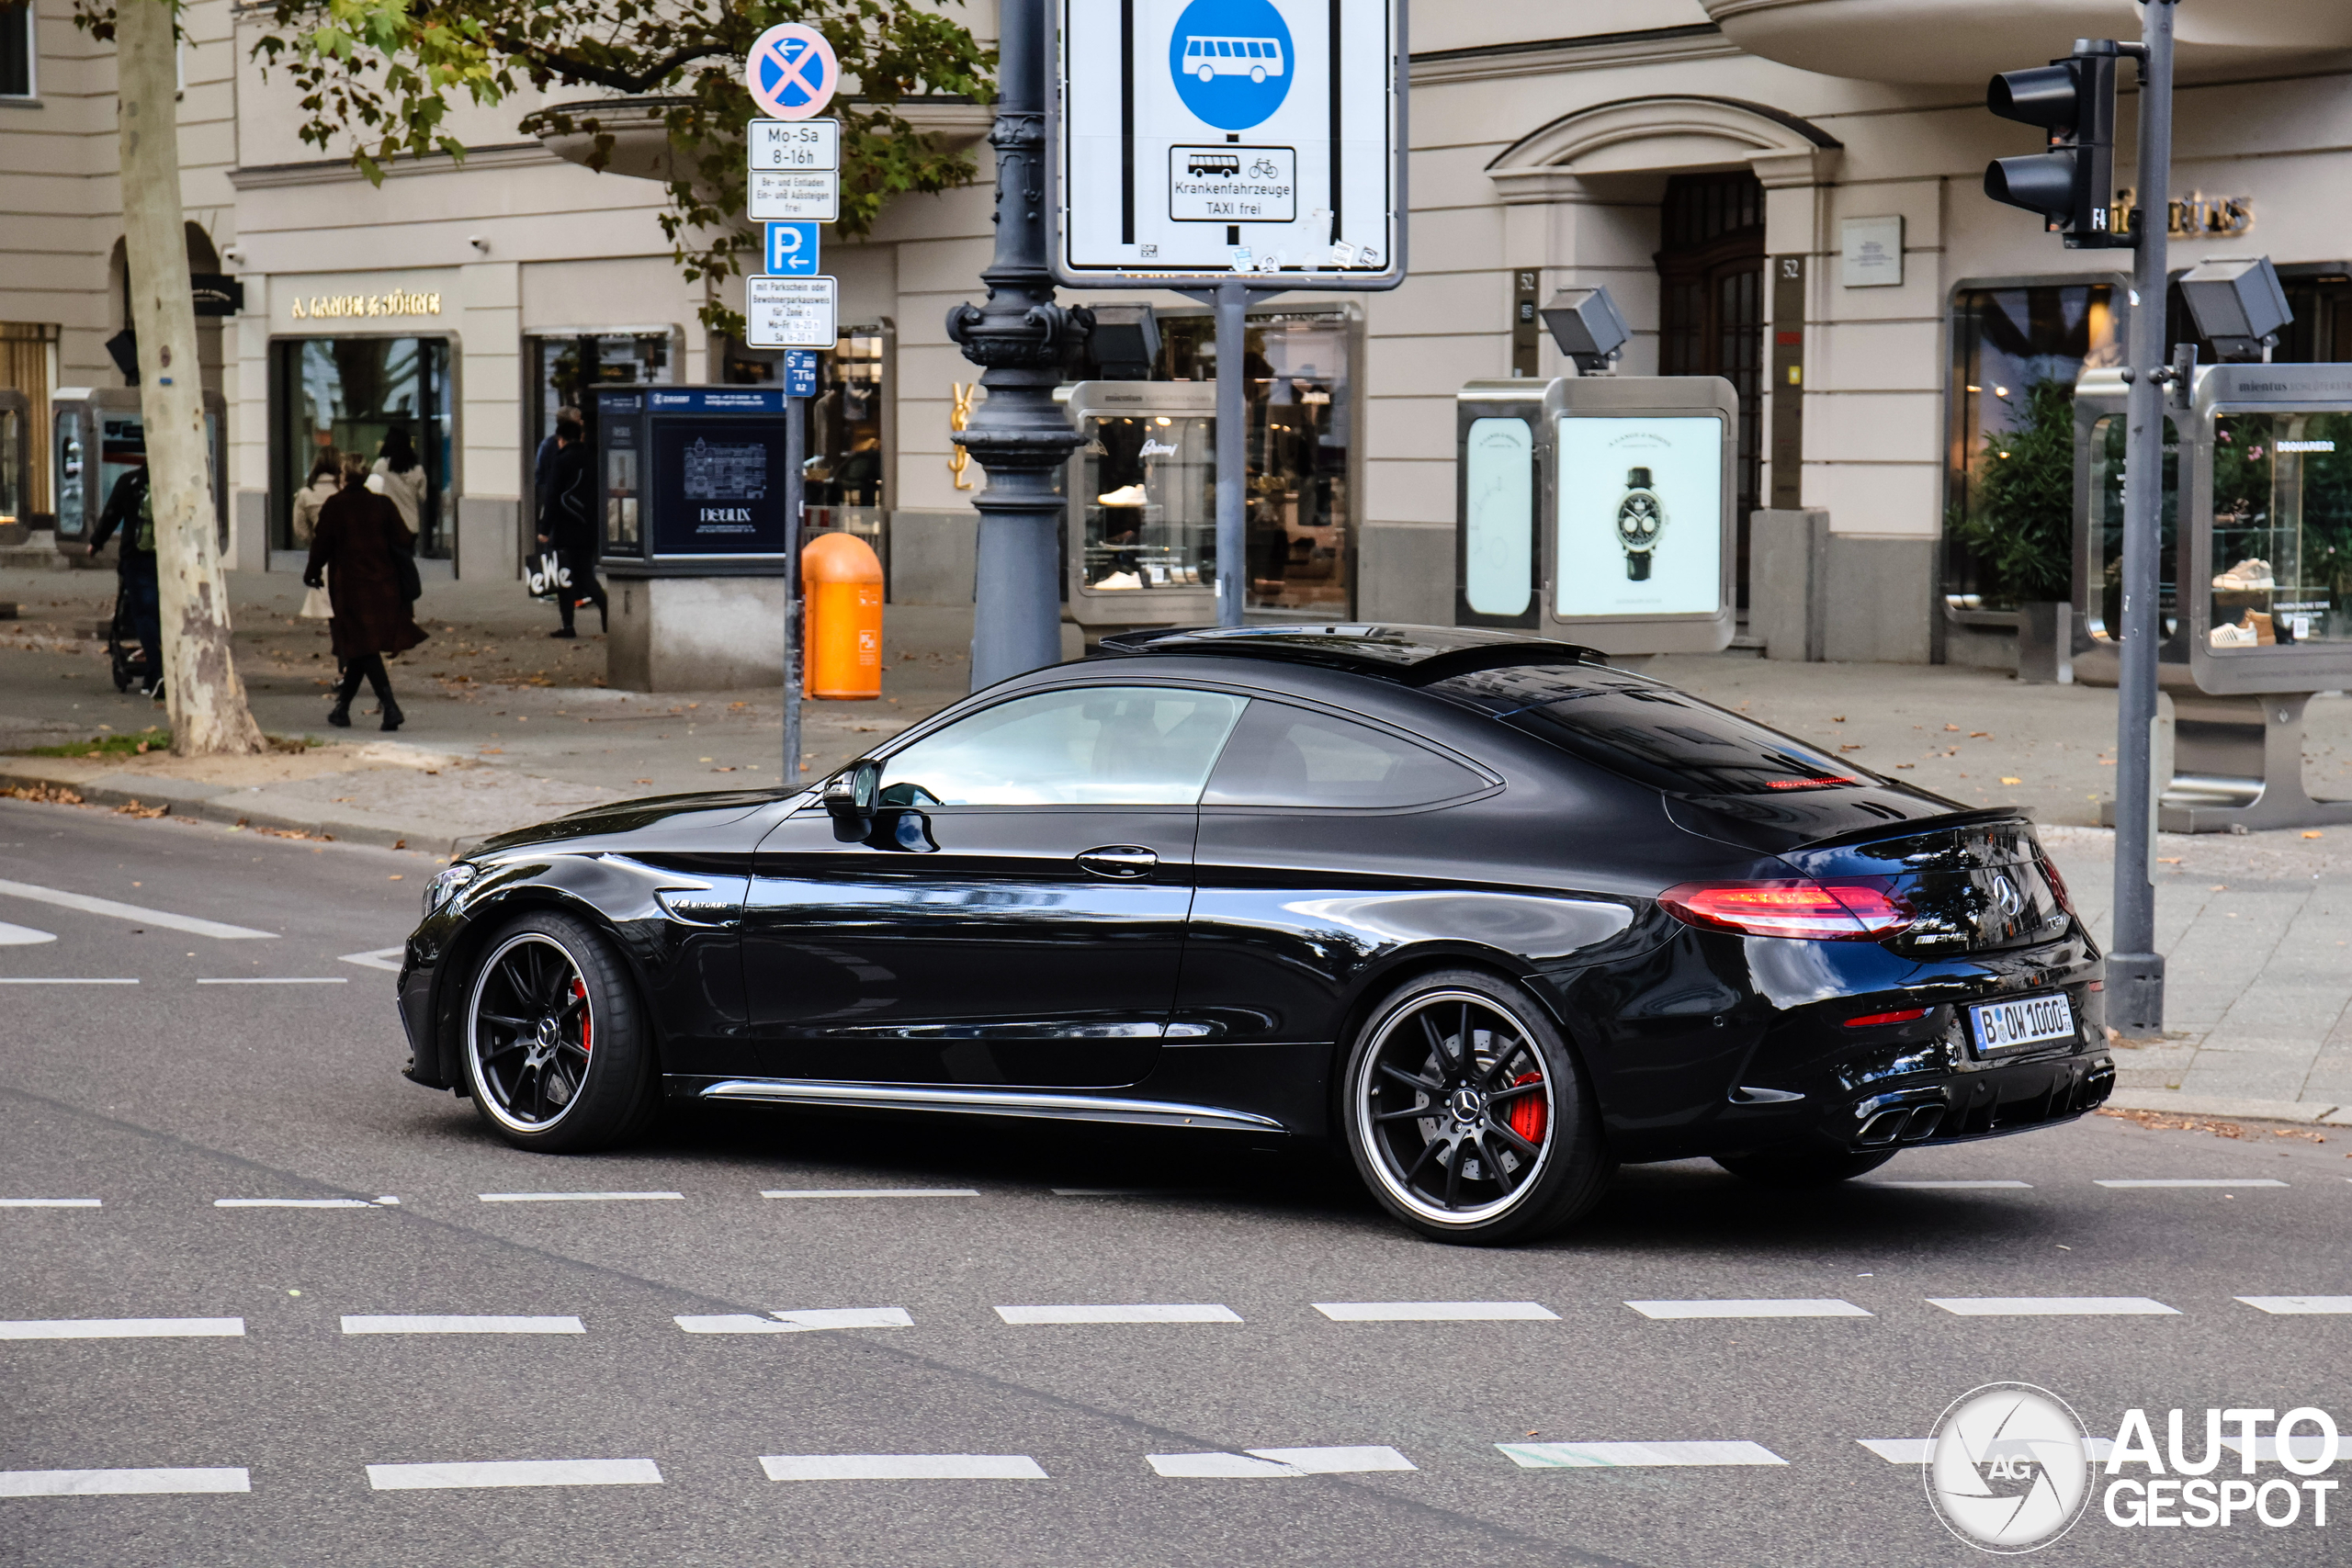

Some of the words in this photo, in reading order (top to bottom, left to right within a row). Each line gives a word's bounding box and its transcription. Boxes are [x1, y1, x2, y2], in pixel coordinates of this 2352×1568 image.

[768, 128, 819, 142] Mo-Sa
[773, 150, 814, 164] 8-16h
[762, 177, 775, 186] Be-
[778, 177, 791, 186] und
[794, 177, 825, 187] Entladen
[756, 190, 772, 198] Ein-
[775, 190, 787, 199] und
[791, 190, 830, 201] Aussteigen
[1174, 182, 1291, 197] Krankenfahrzeuge
[785, 203, 801, 212] frei
[1206, 201, 1234, 215] TAXI
[1239, 202, 1261, 215] frei
[2092, 208, 2108, 231] F4
[774, 226, 803, 269] P
[1782, 259, 1799, 278] 52
[756, 282, 768, 291] mit
[771, 282, 808, 291] Parkschein
[811, 282, 827, 291] oder
[1521, 273, 1535, 290] 52
[310, 295, 366, 318] LANGE
[368, 294, 380, 318] &
[381, 288, 441, 317] SÖHNE
[753, 295, 831, 306] Bewohnerparkausweis
[773, 307, 783, 317] für
[786, 307, 802, 317] Zone
[768, 320, 790, 329] Mo-Fr
[775, 333, 784, 342] Sa
[787, 355, 796, 367] S
[2238, 380, 2288, 392] mientus
[2277, 441, 2335, 453] DSQUARED2
[1982, 1010, 1997, 1043] B
[2005, 1005, 2028, 1040] OW
[2026, 999, 2064, 1037] 1000
